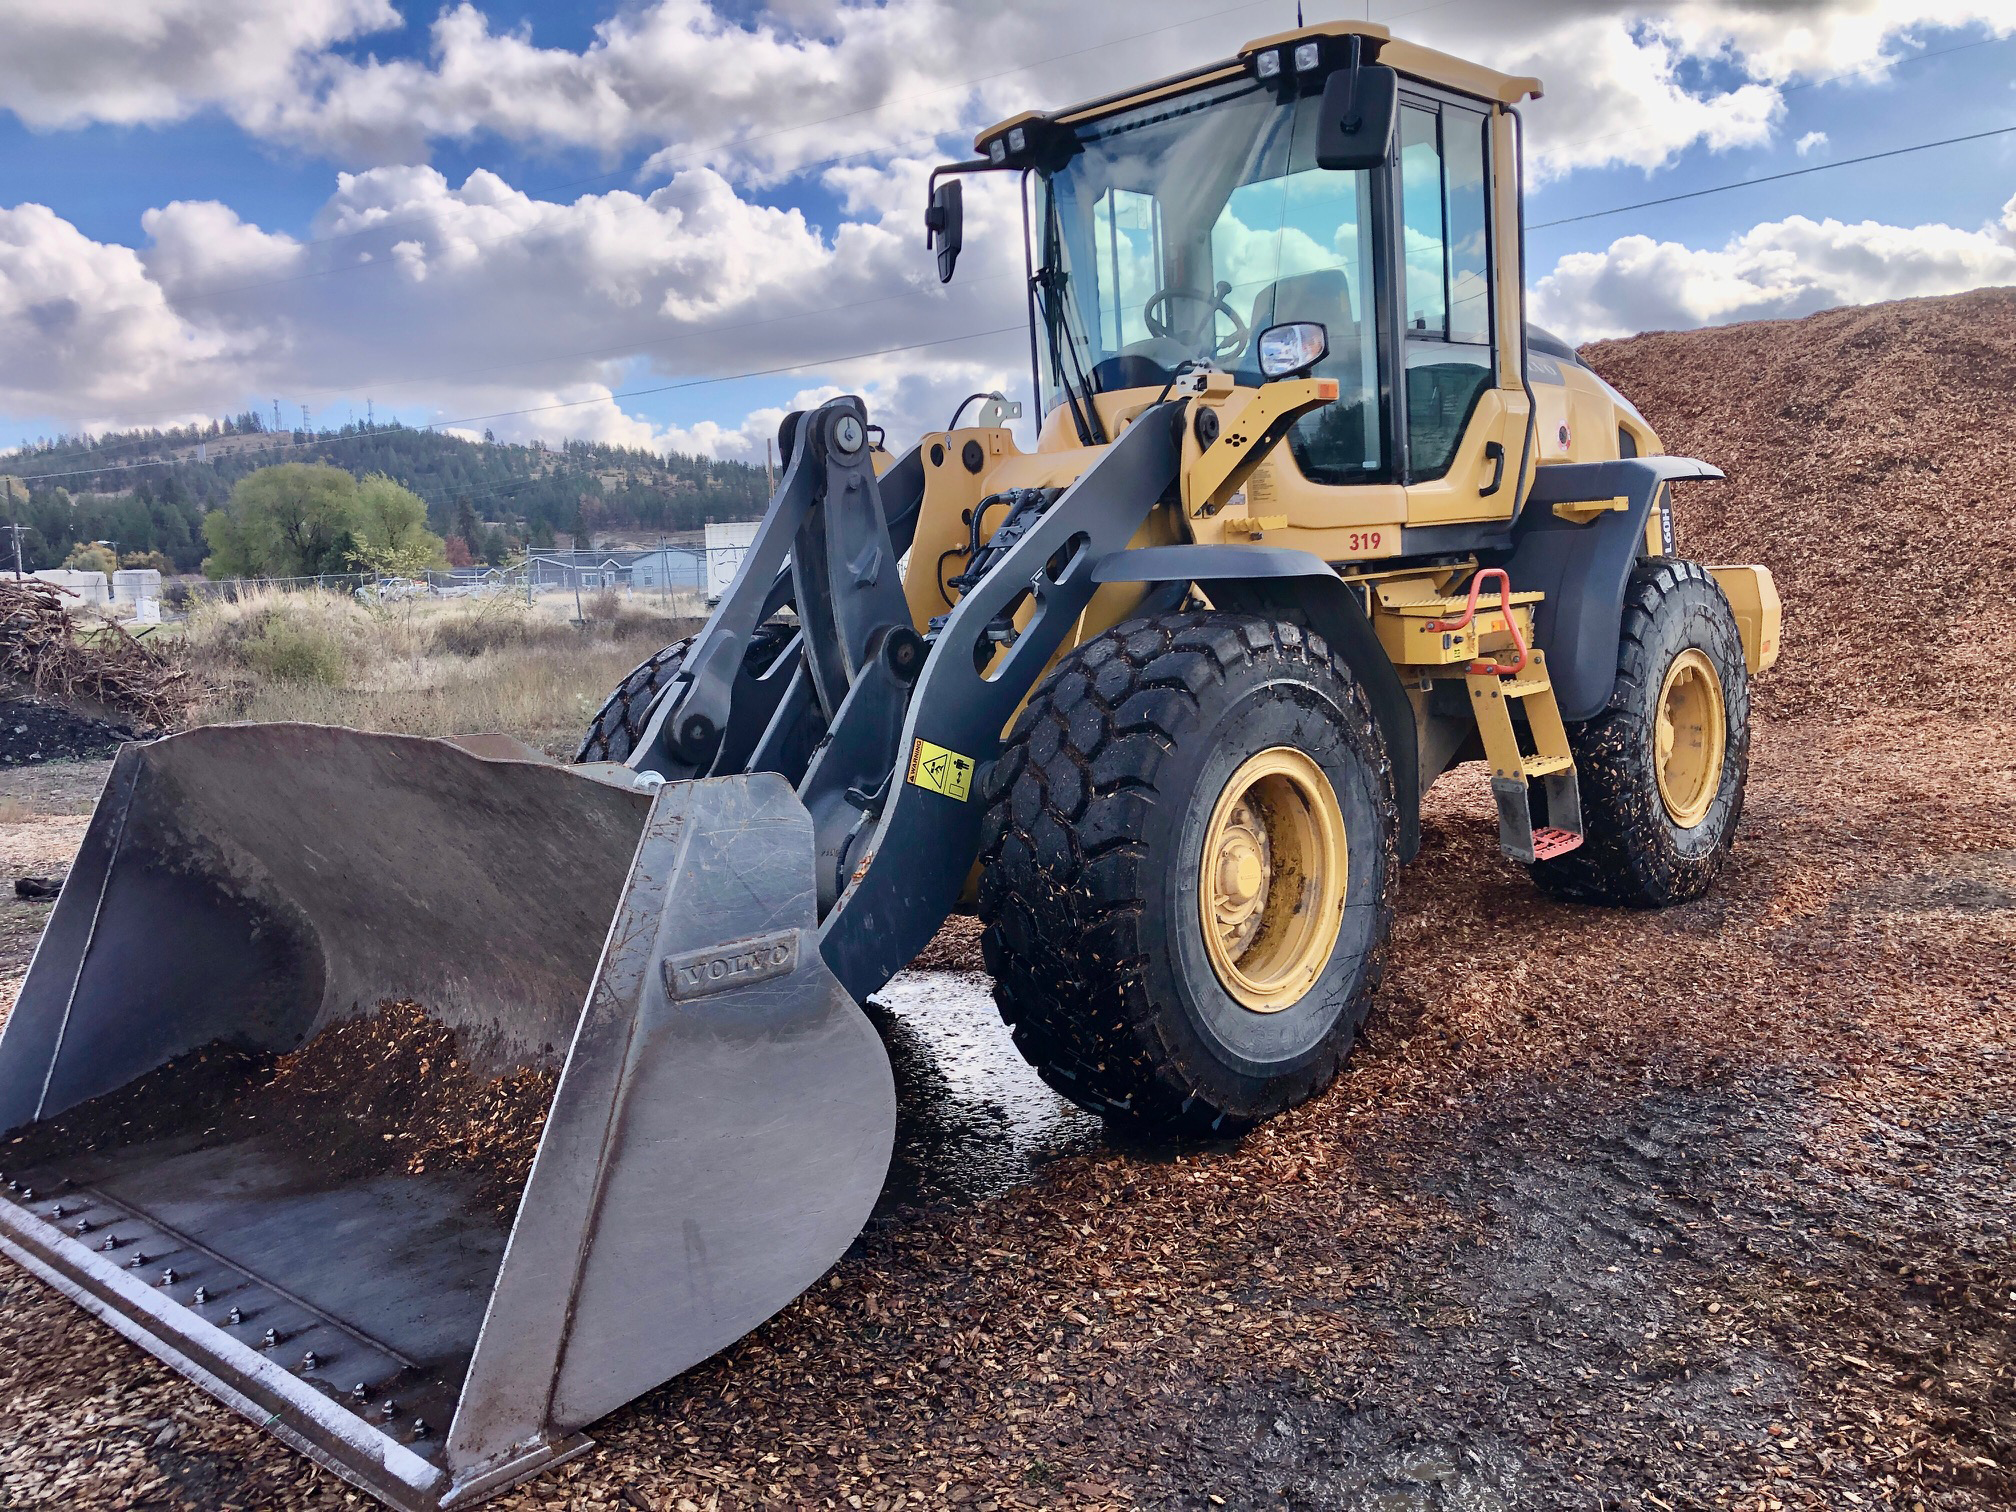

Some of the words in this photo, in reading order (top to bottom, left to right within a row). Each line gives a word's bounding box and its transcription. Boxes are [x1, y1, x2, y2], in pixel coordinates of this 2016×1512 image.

[1349, 532, 1382, 551] 319
[1662, 508, 1672, 554] L60H
[911, 740, 922, 774] WARNING
[679, 945, 790, 985] VOLVO
